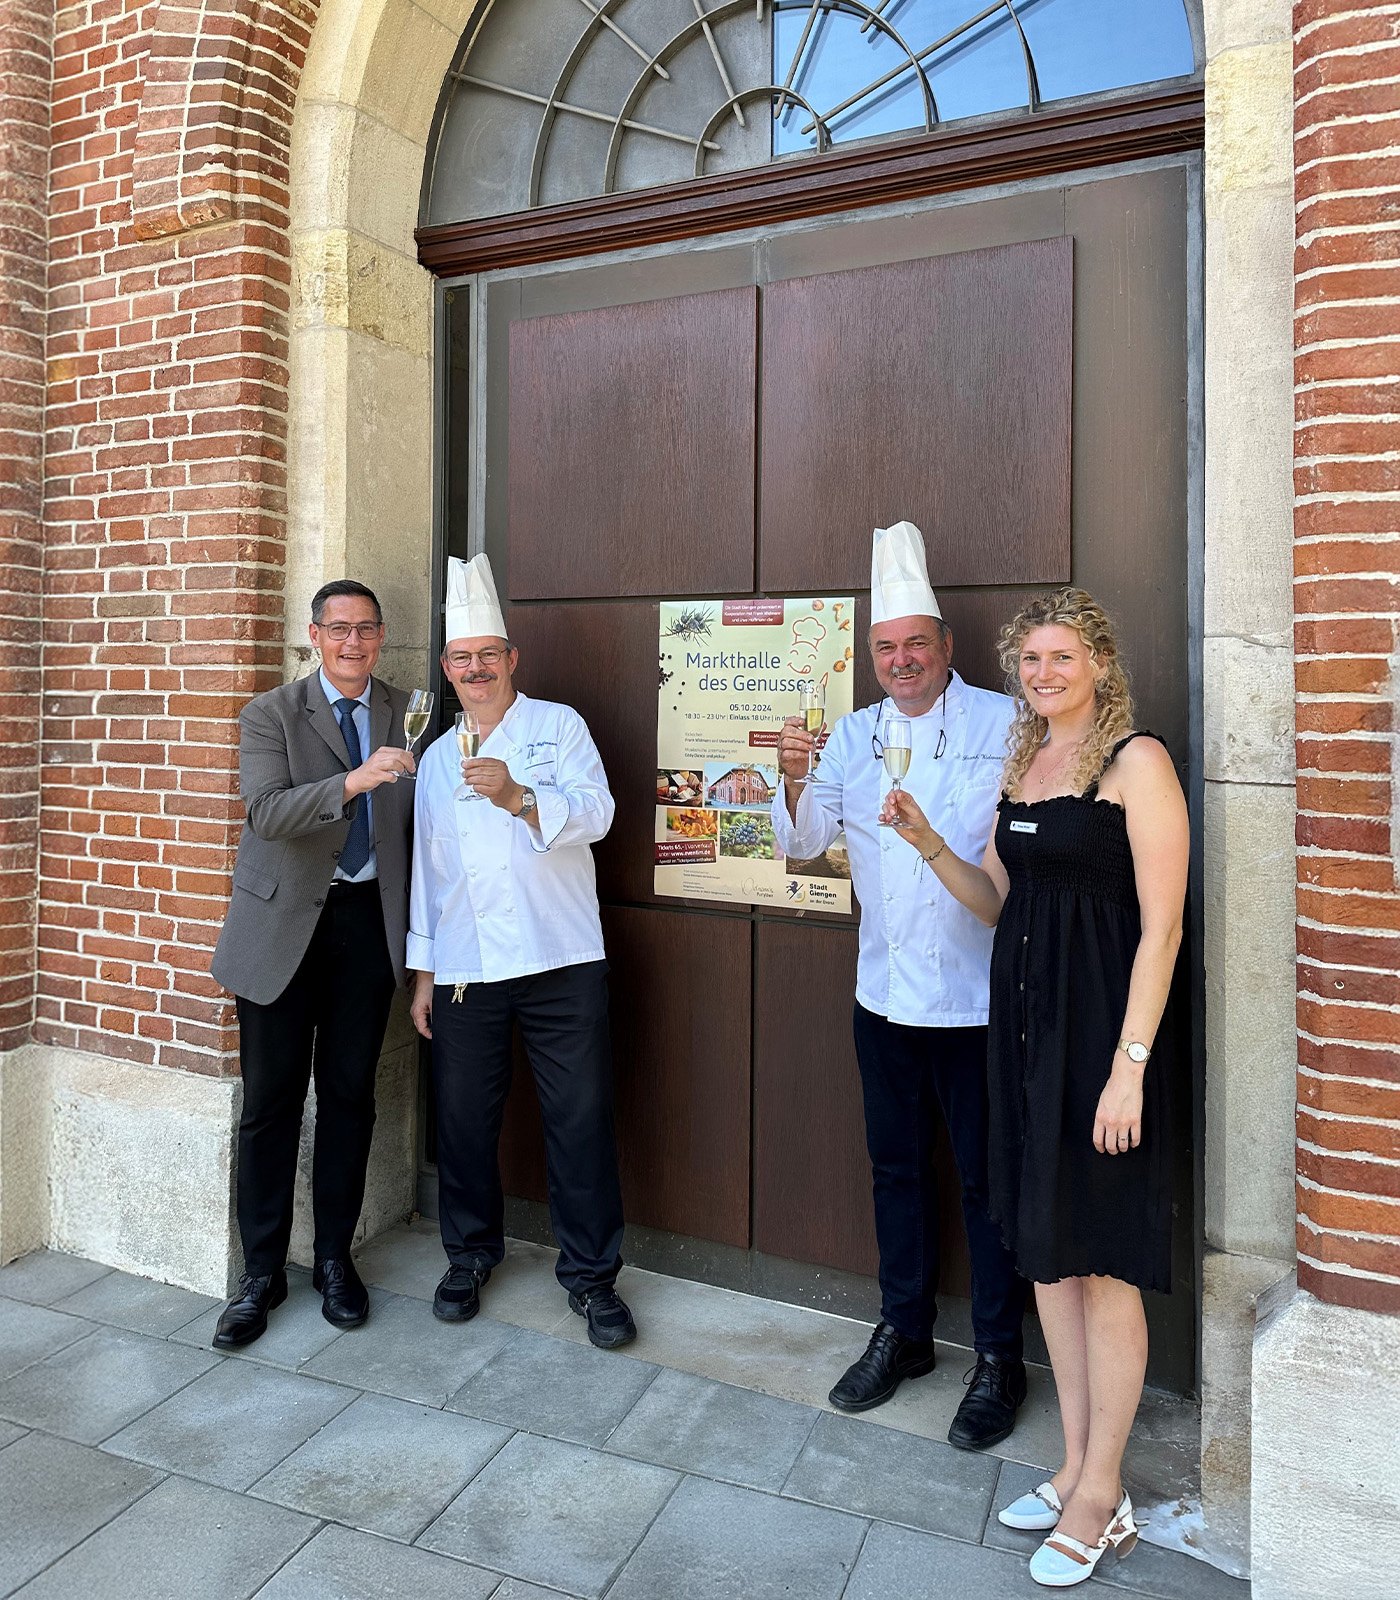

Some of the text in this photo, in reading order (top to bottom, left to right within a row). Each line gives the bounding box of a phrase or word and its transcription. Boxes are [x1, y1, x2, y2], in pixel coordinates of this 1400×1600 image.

[686, 652, 780, 669] Markthalle
[698, 674, 728, 691] des
[729, 704, 772, 712] 05.10.2024
[810, 890, 837, 898] Giengen
